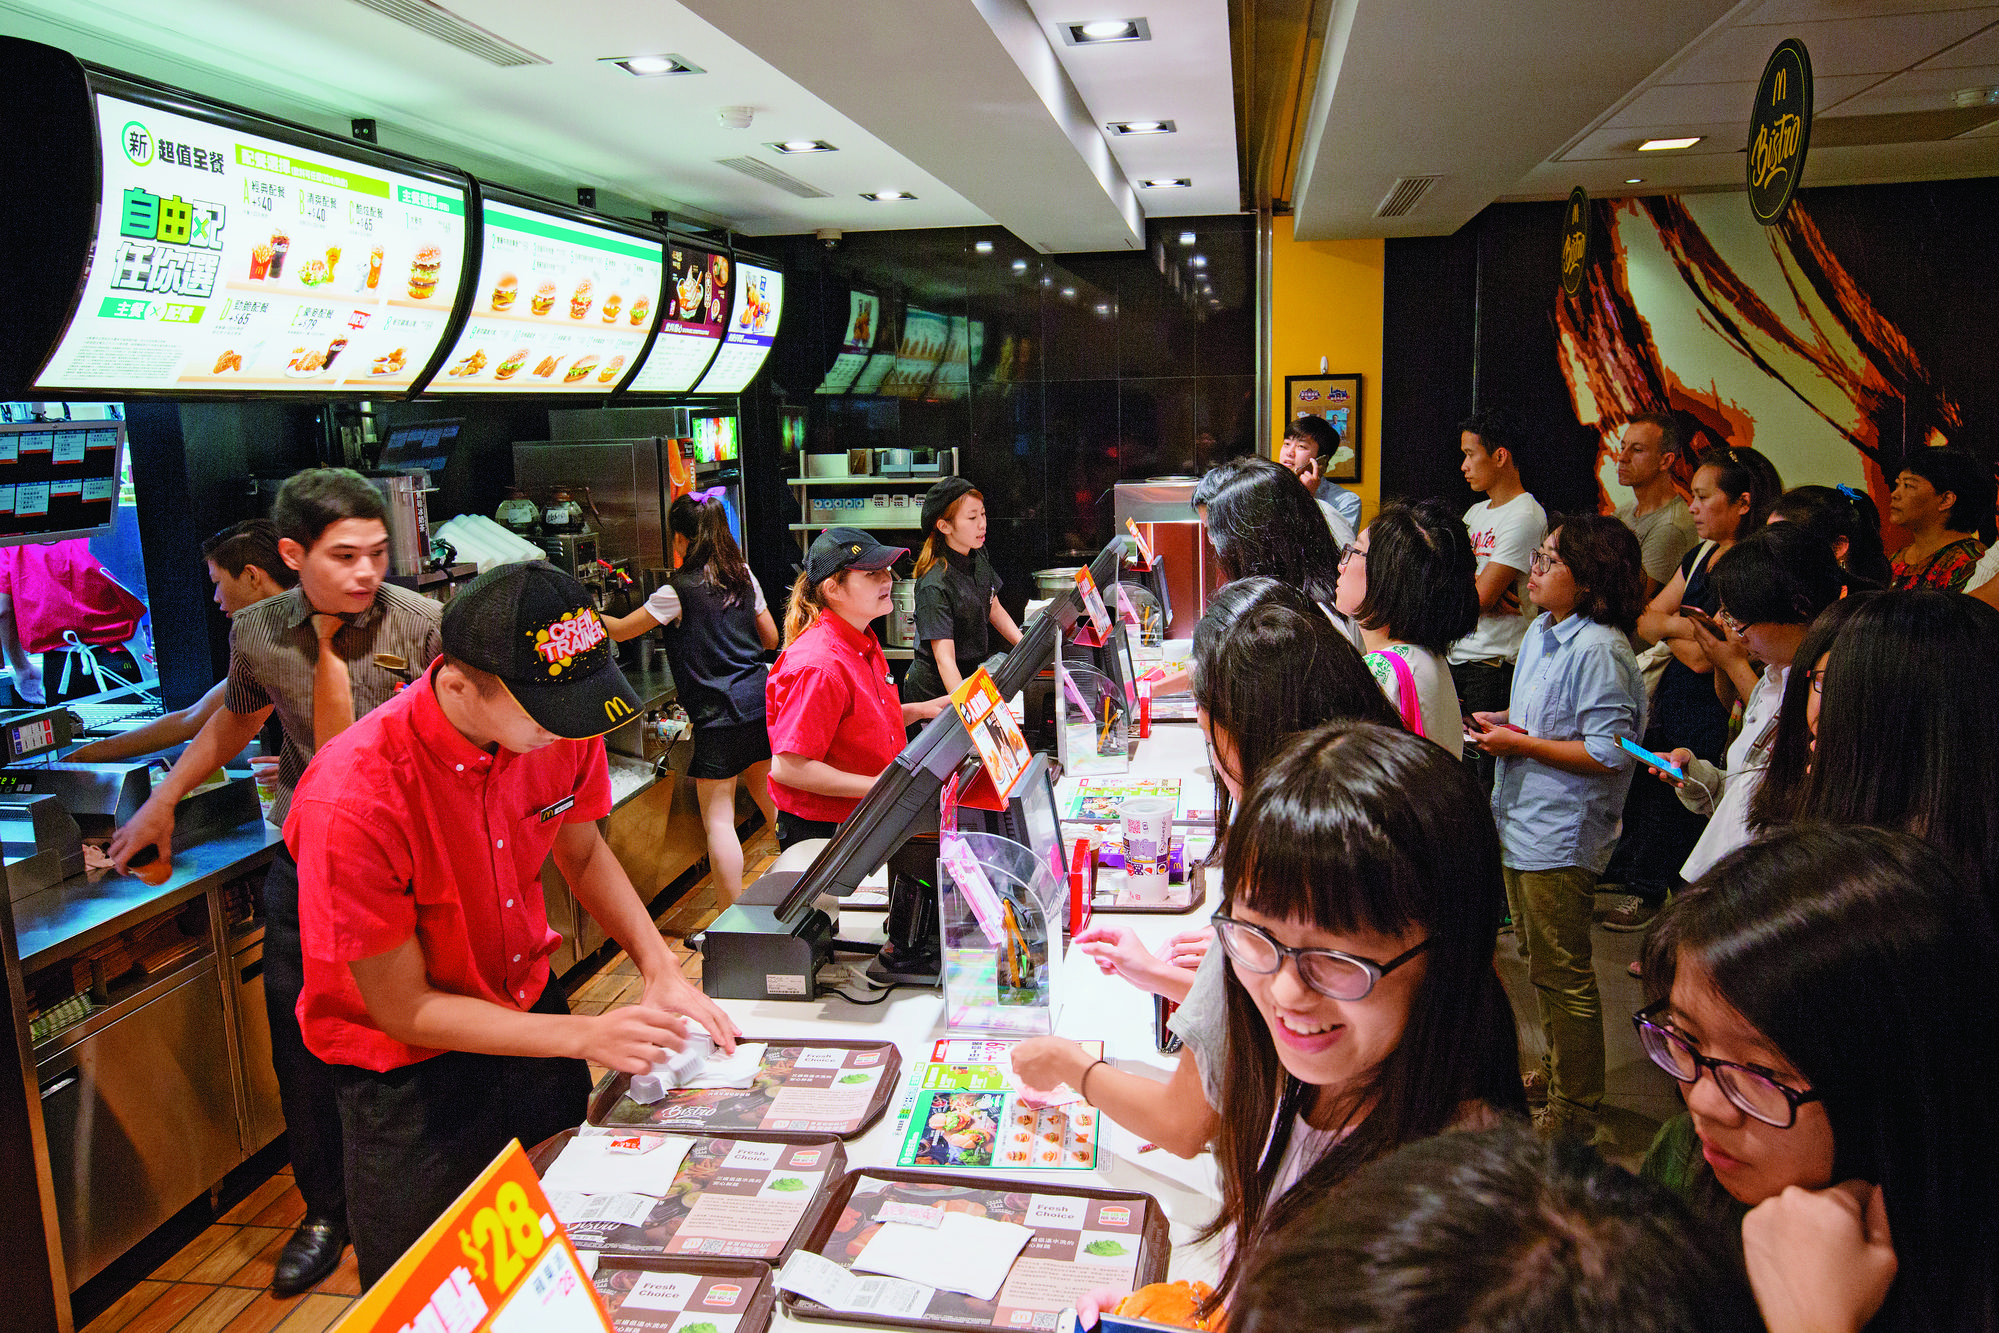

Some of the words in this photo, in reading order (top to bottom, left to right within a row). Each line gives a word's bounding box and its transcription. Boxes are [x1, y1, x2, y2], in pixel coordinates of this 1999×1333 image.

[129, 131, 148, 159] 新
[158, 138, 225, 176] 超值全餐
[1751, 113, 1801, 188] Bistro
[1562, 231, 1586, 274] Bistro
[110, 240, 221, 299] 任你選
[114, 302, 146, 318] 主餐
[539, 620, 606, 662] TRAINER
[549, 608, 594, 641] CREW
[661, 1105, 718, 1119] Bistro
[1035, 1210, 1075, 1219] Choice
[1036, 1204, 1069, 1212] Fresh
[457, 1180, 545, 1295] $28
[638, 1290, 680, 1299] Choice
[643, 1282, 676, 1290] Fresh
